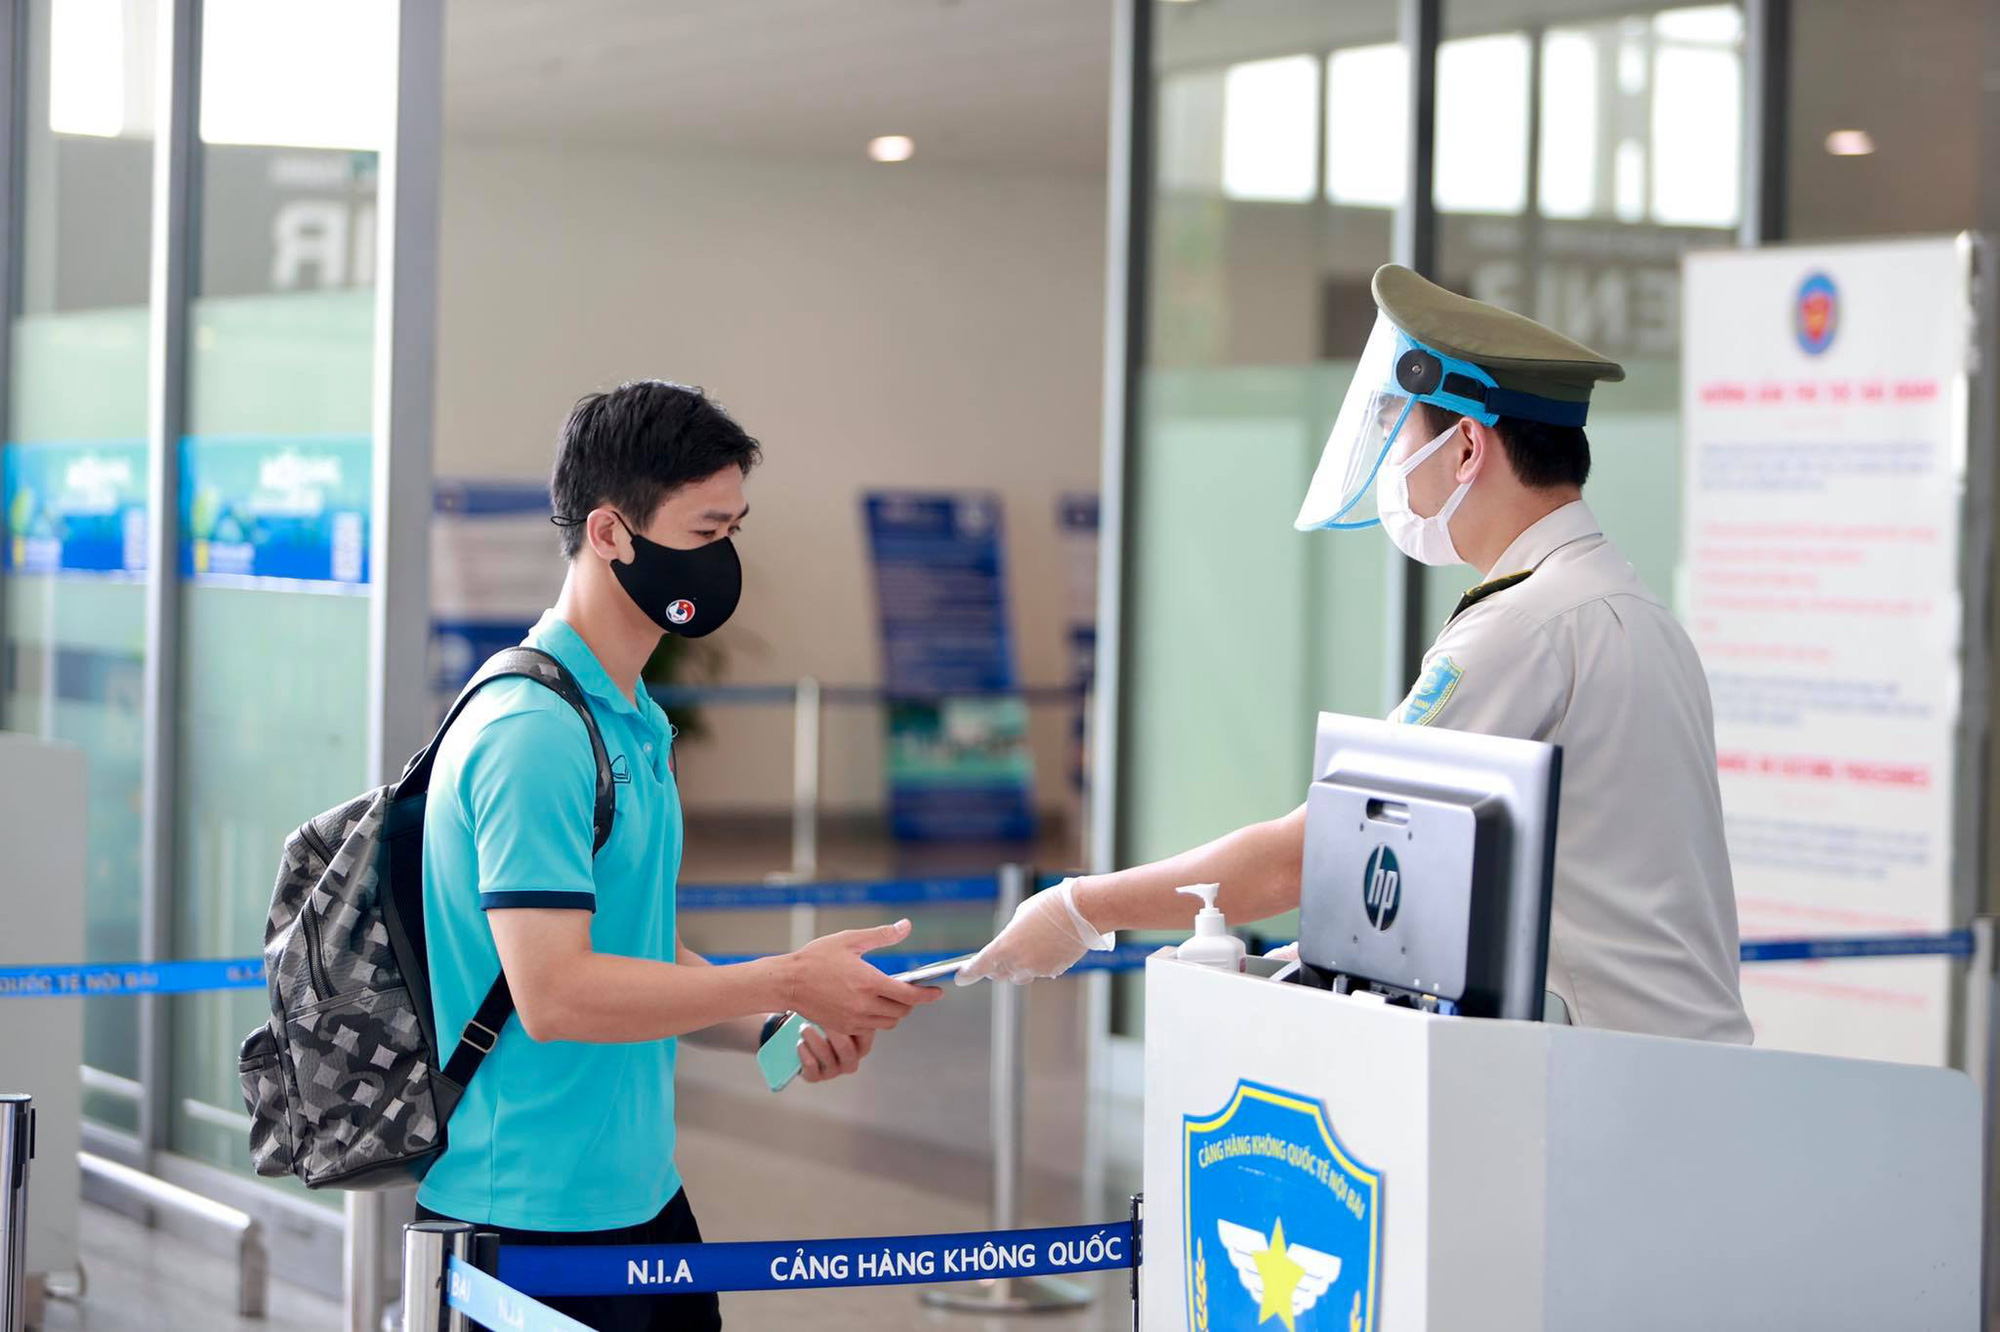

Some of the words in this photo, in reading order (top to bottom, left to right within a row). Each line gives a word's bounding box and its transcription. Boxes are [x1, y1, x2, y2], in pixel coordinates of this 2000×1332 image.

[1366, 844, 1399, 931] hp
[1223, 1133, 1251, 1158] HÀNG
[1251, 1132, 1286, 1161] KHÔNG
[1287, 1143, 1317, 1176] QUỐC
[627, 1258, 694, 1285] N.I.A
[770, 1248, 849, 1281] CẢNG
[857, 1248, 935, 1278] HÀNG
[944, 1241, 1036, 1274] KHÔNG
[1048, 1230, 1122, 1266] QUỐC
